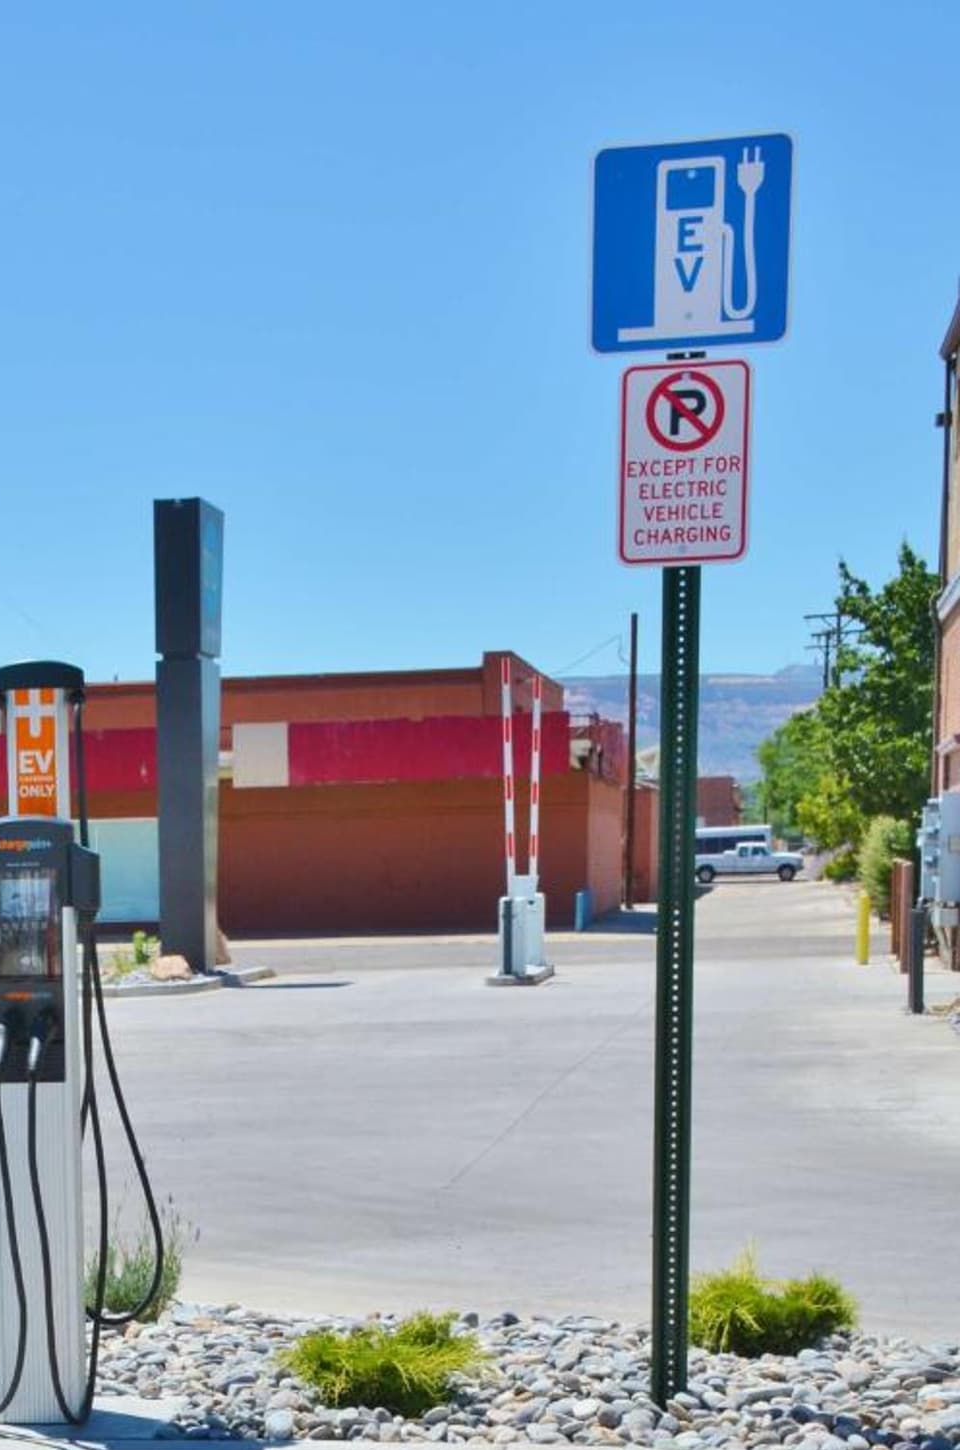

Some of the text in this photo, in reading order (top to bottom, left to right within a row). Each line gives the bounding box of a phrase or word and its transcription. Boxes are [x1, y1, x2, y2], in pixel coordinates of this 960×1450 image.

[674, 216, 704, 293] EV
[669, 389, 707, 436] P
[627, 455, 741, 478] EXCEPT FOR
[638, 479, 727, 500] ELECTRIC
[644, 502, 724, 522] VEHICLE
[633, 525, 731, 546] CHARGING
[19, 749, 54, 774] EV
[19, 784, 55, 798] ONLY
